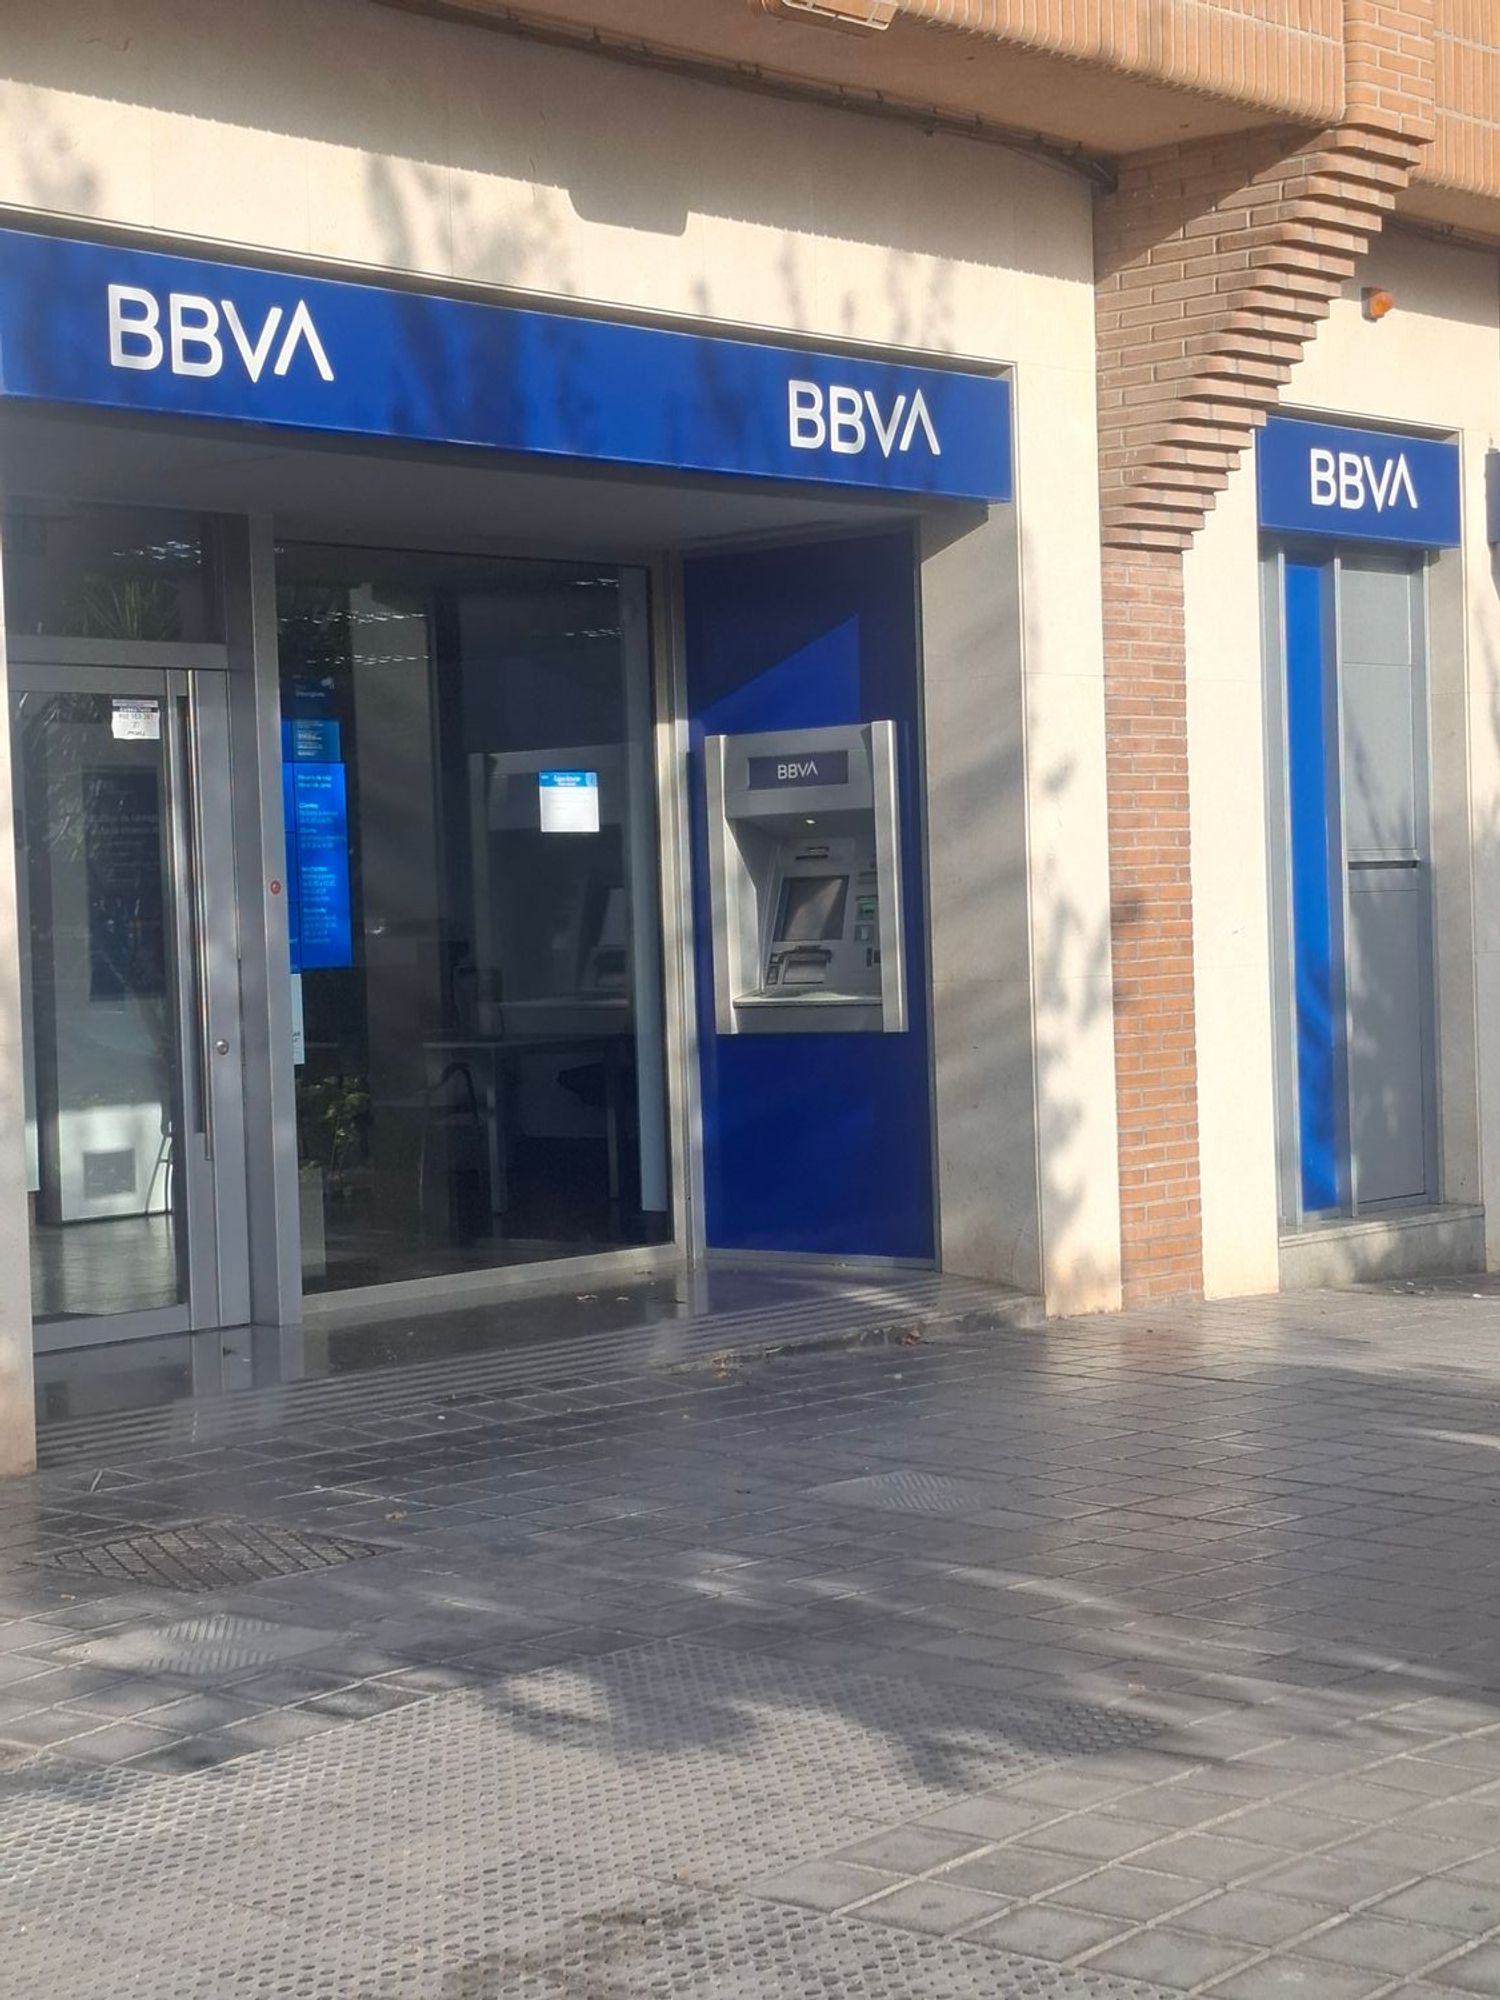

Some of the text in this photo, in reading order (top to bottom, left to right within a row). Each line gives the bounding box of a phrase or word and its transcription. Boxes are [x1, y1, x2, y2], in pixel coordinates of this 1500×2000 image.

[107, 283, 335, 384] BBVA
[788, 379, 941, 459] BBVA
[1310, 447, 1418, 513] BBVA
[777, 761, 818, 780] BBVA
